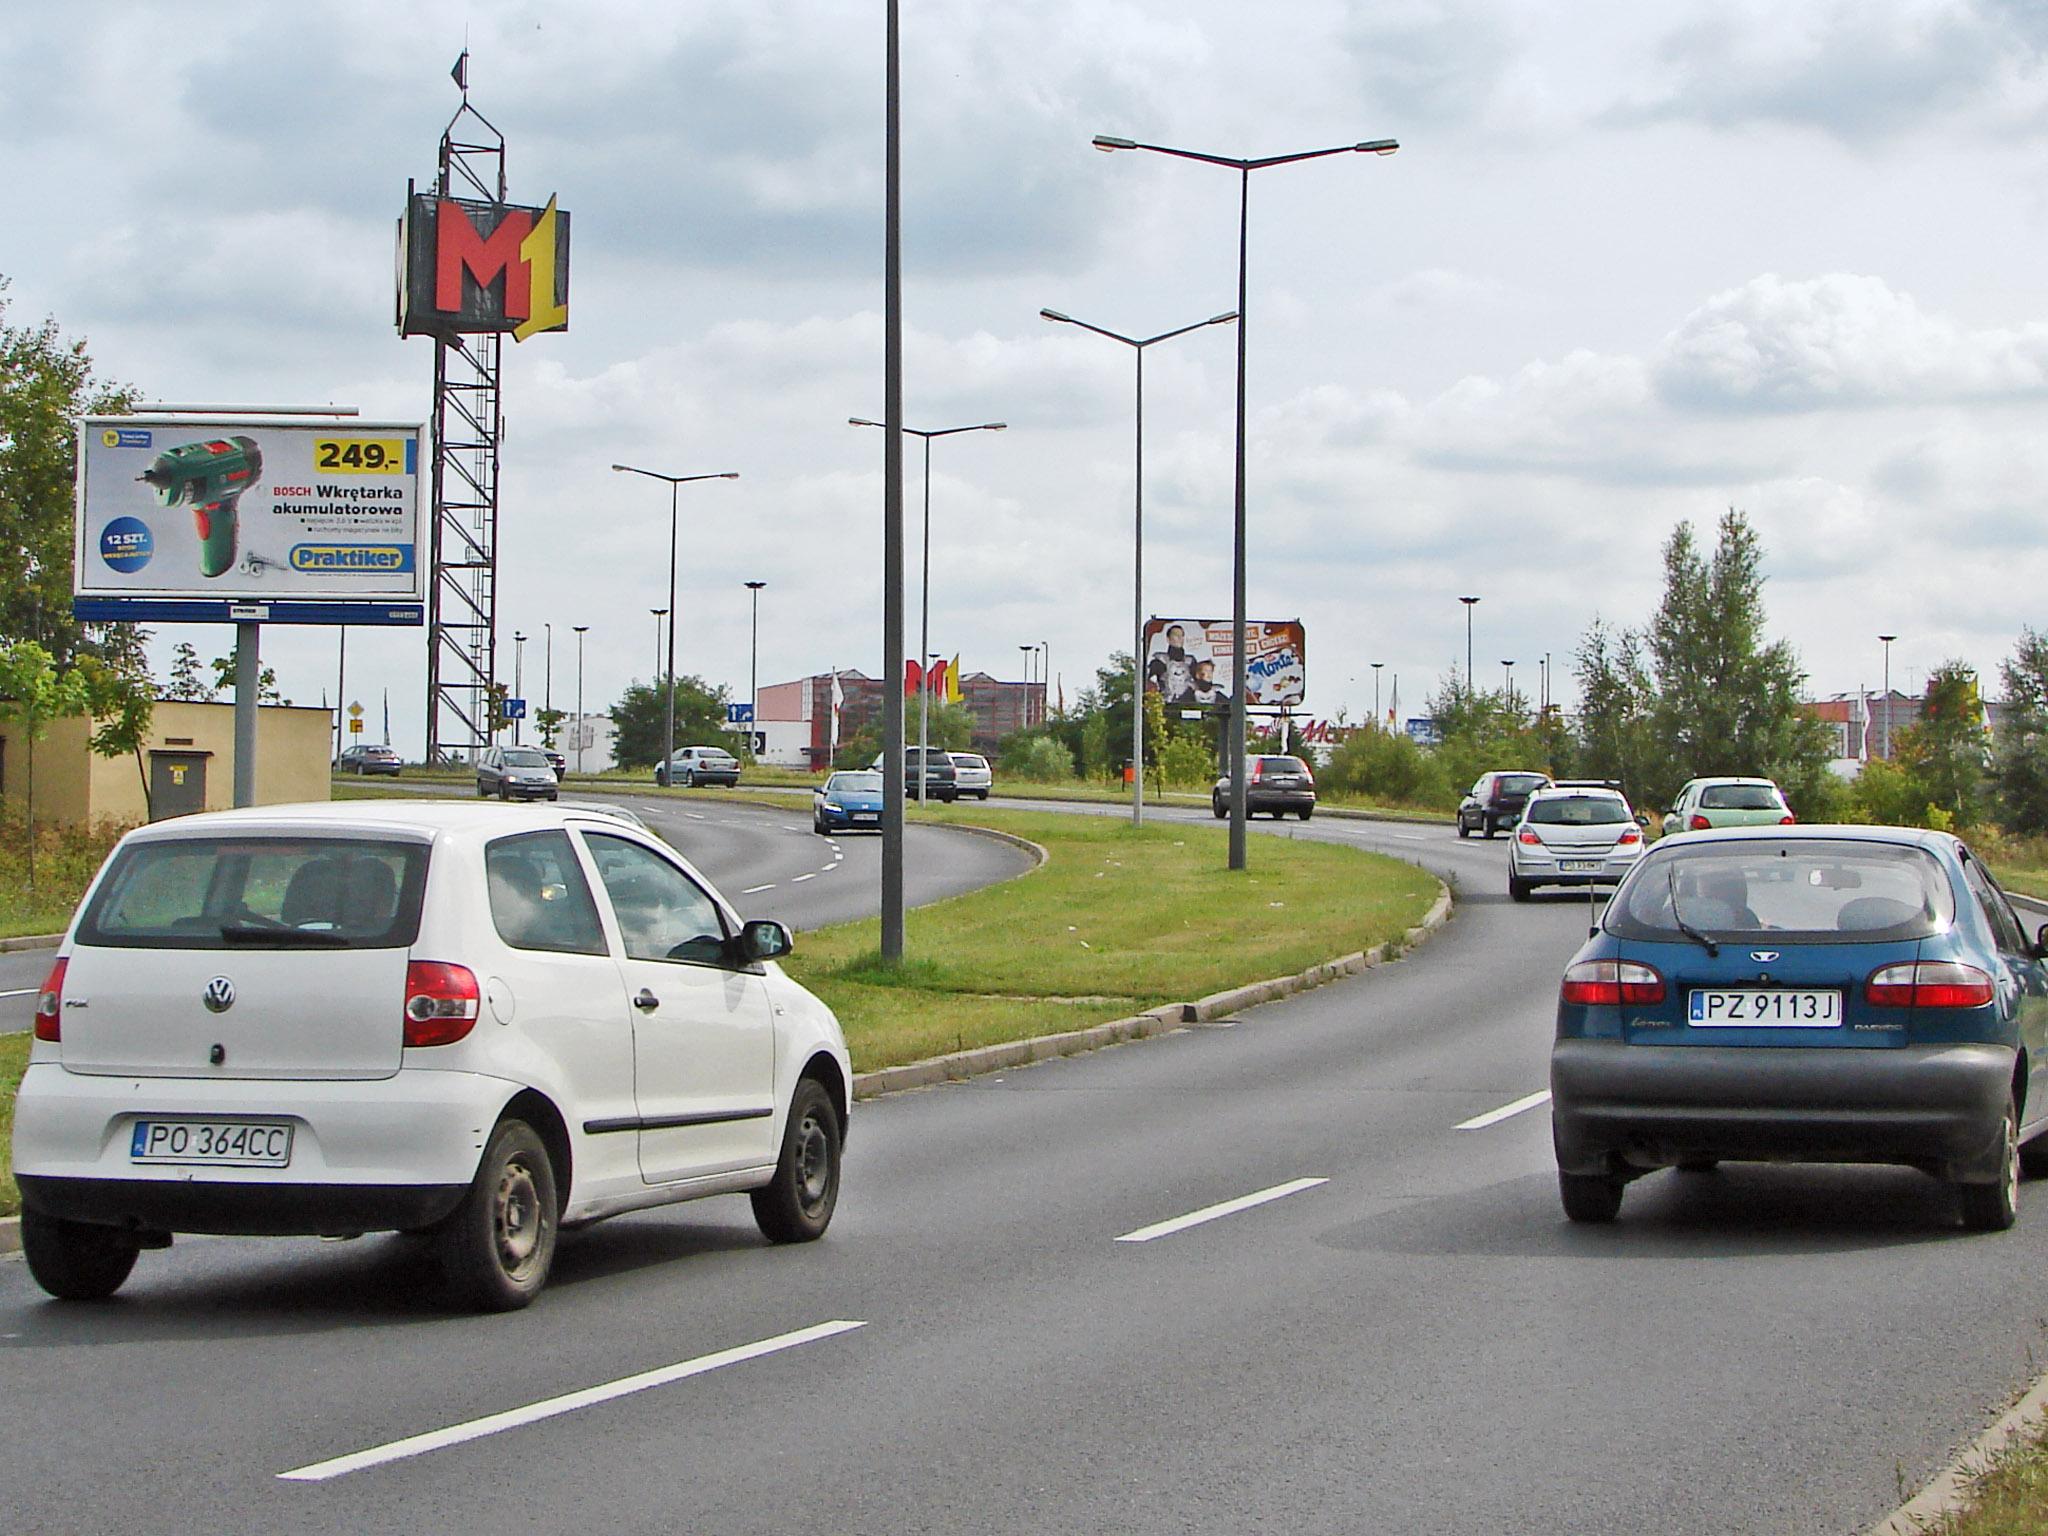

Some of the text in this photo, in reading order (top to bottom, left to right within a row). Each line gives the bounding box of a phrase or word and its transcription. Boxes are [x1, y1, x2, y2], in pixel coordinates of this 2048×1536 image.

[436, 192, 567, 343] M1
[273, 485, 403, 502] BOSCH Wkrętarka
[272, 502, 403, 515] akumulatorowa
[107, 534, 121, 545] 12
[298, 549, 401, 567] Praktiker
[1708, 994, 1744, 1019] PZ
[1755, 994, 1832, 1019] 9113J
[149, 1126, 284, 1157] PO 364CC
